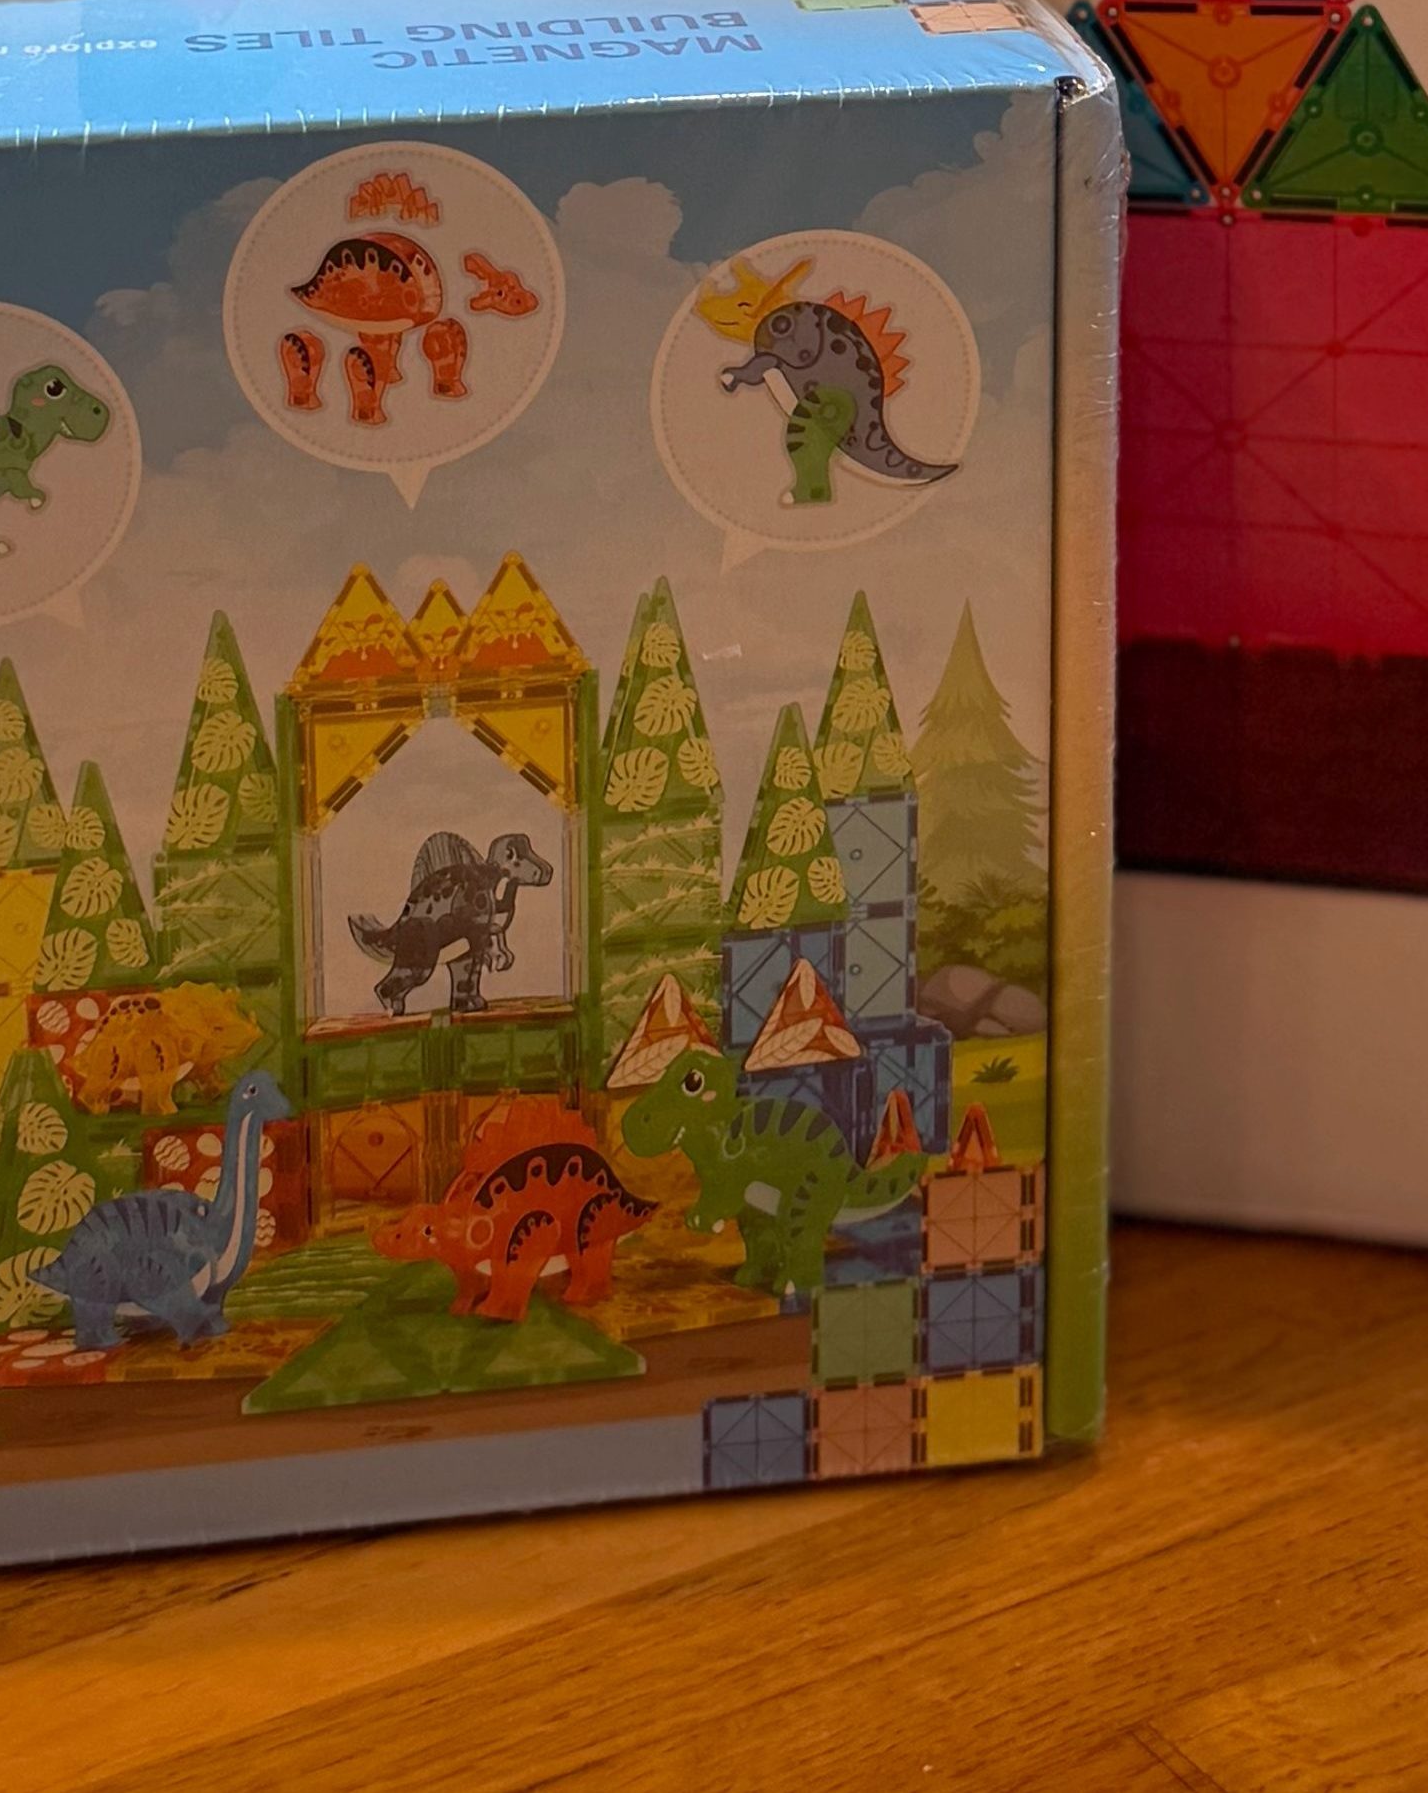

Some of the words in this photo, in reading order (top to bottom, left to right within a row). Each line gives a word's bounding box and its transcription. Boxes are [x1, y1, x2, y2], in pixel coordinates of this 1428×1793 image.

[184, 27, 383, 53] TILES
[405, 11, 749, 43] BUILDING
[23, 39, 157, 54] explore
[371, 34, 764, 70] MAGNETIC
